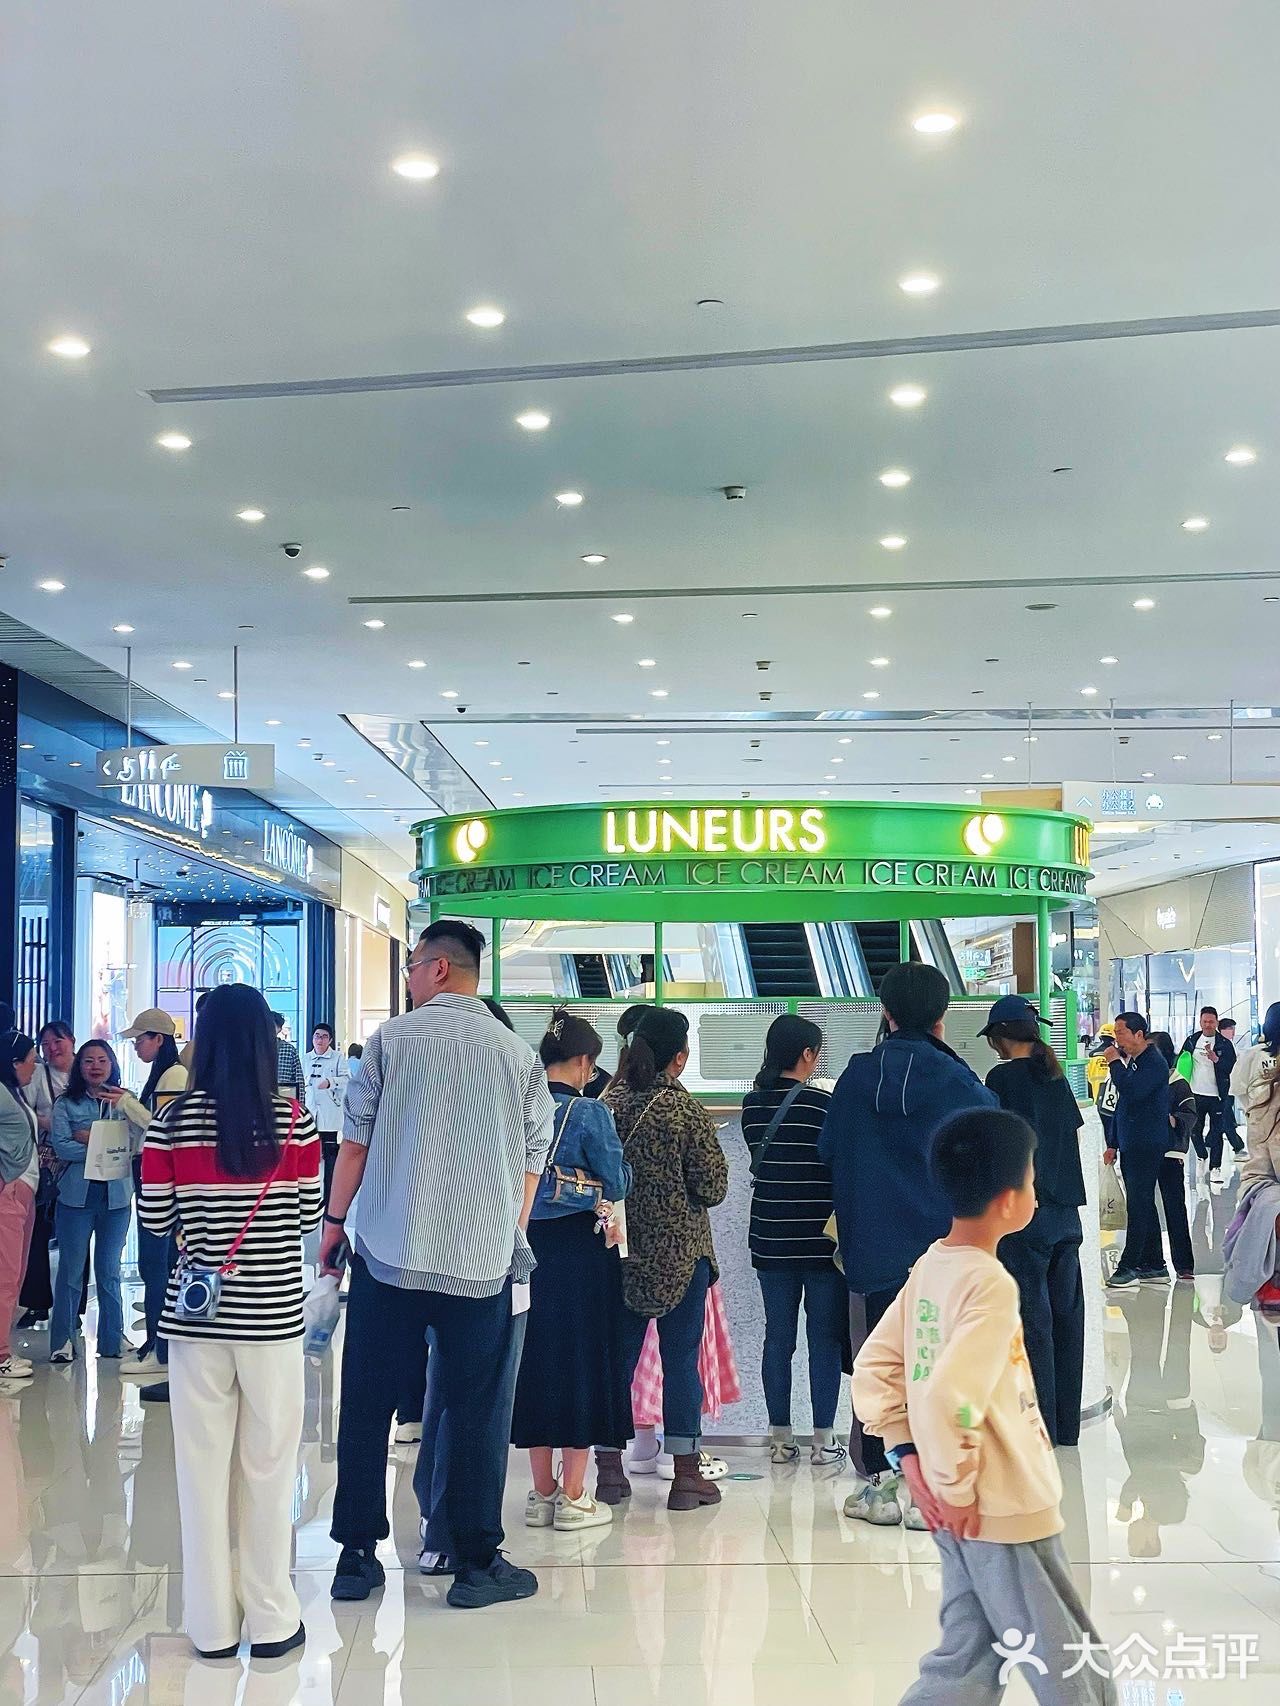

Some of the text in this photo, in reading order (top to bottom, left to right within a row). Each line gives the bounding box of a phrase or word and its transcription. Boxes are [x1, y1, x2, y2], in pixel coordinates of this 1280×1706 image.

[263, 819, 308, 880] LANCÔME
[605, 808, 827, 854] LUNEURS
[456, 868, 516, 892] CREAM
[528, 866, 565, 889] ICE
[569, 864, 666, 887] CREAM
[685, 862, 730, 885] ICE
[741, 861, 845, 885] CREAM
[865, 861, 908, 886] ICE
[914, 862, 997, 888] CREAM
[1009, 865, 1037, 890] ICE
[1040, 868, 1079, 895] CREAM
